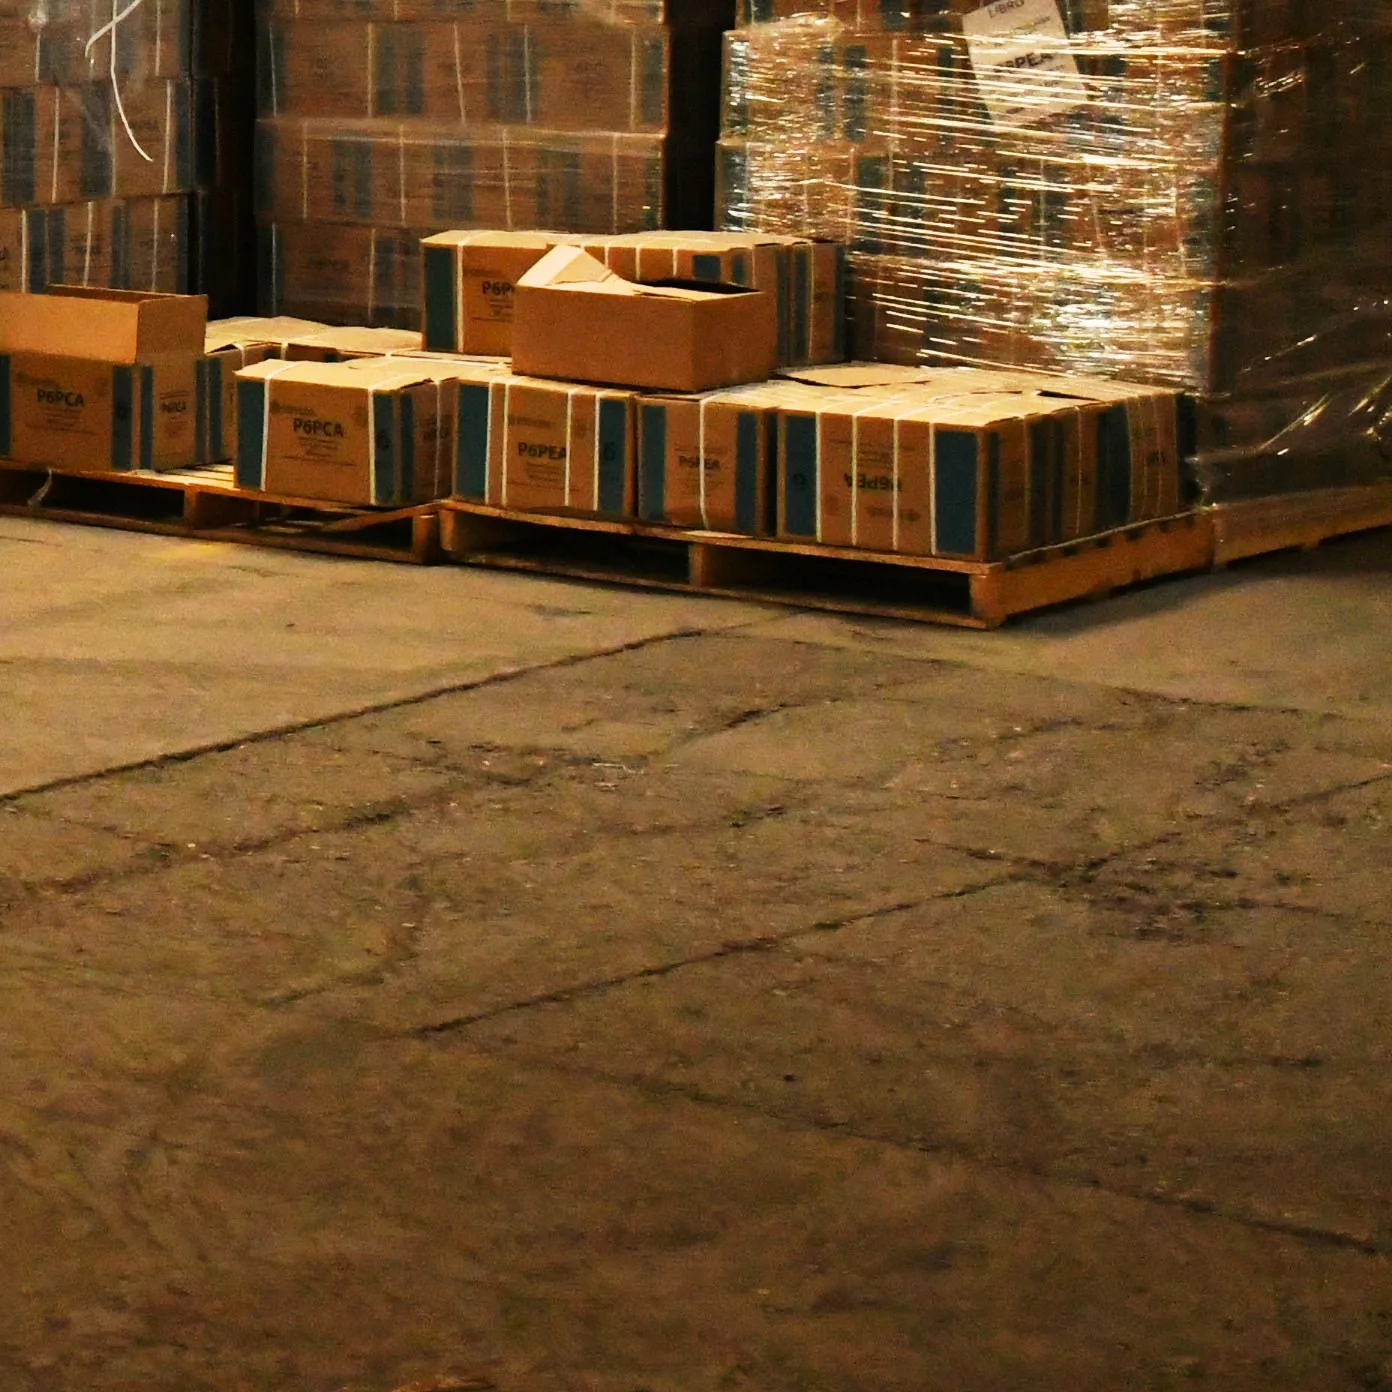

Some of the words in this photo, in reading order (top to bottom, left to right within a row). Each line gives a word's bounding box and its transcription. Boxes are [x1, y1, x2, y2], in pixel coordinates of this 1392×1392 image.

[37, 388, 85, 407] P6PCA
[293, 418, 344, 438] P6PCA
[518, 441, 567, 460] P6PEA
